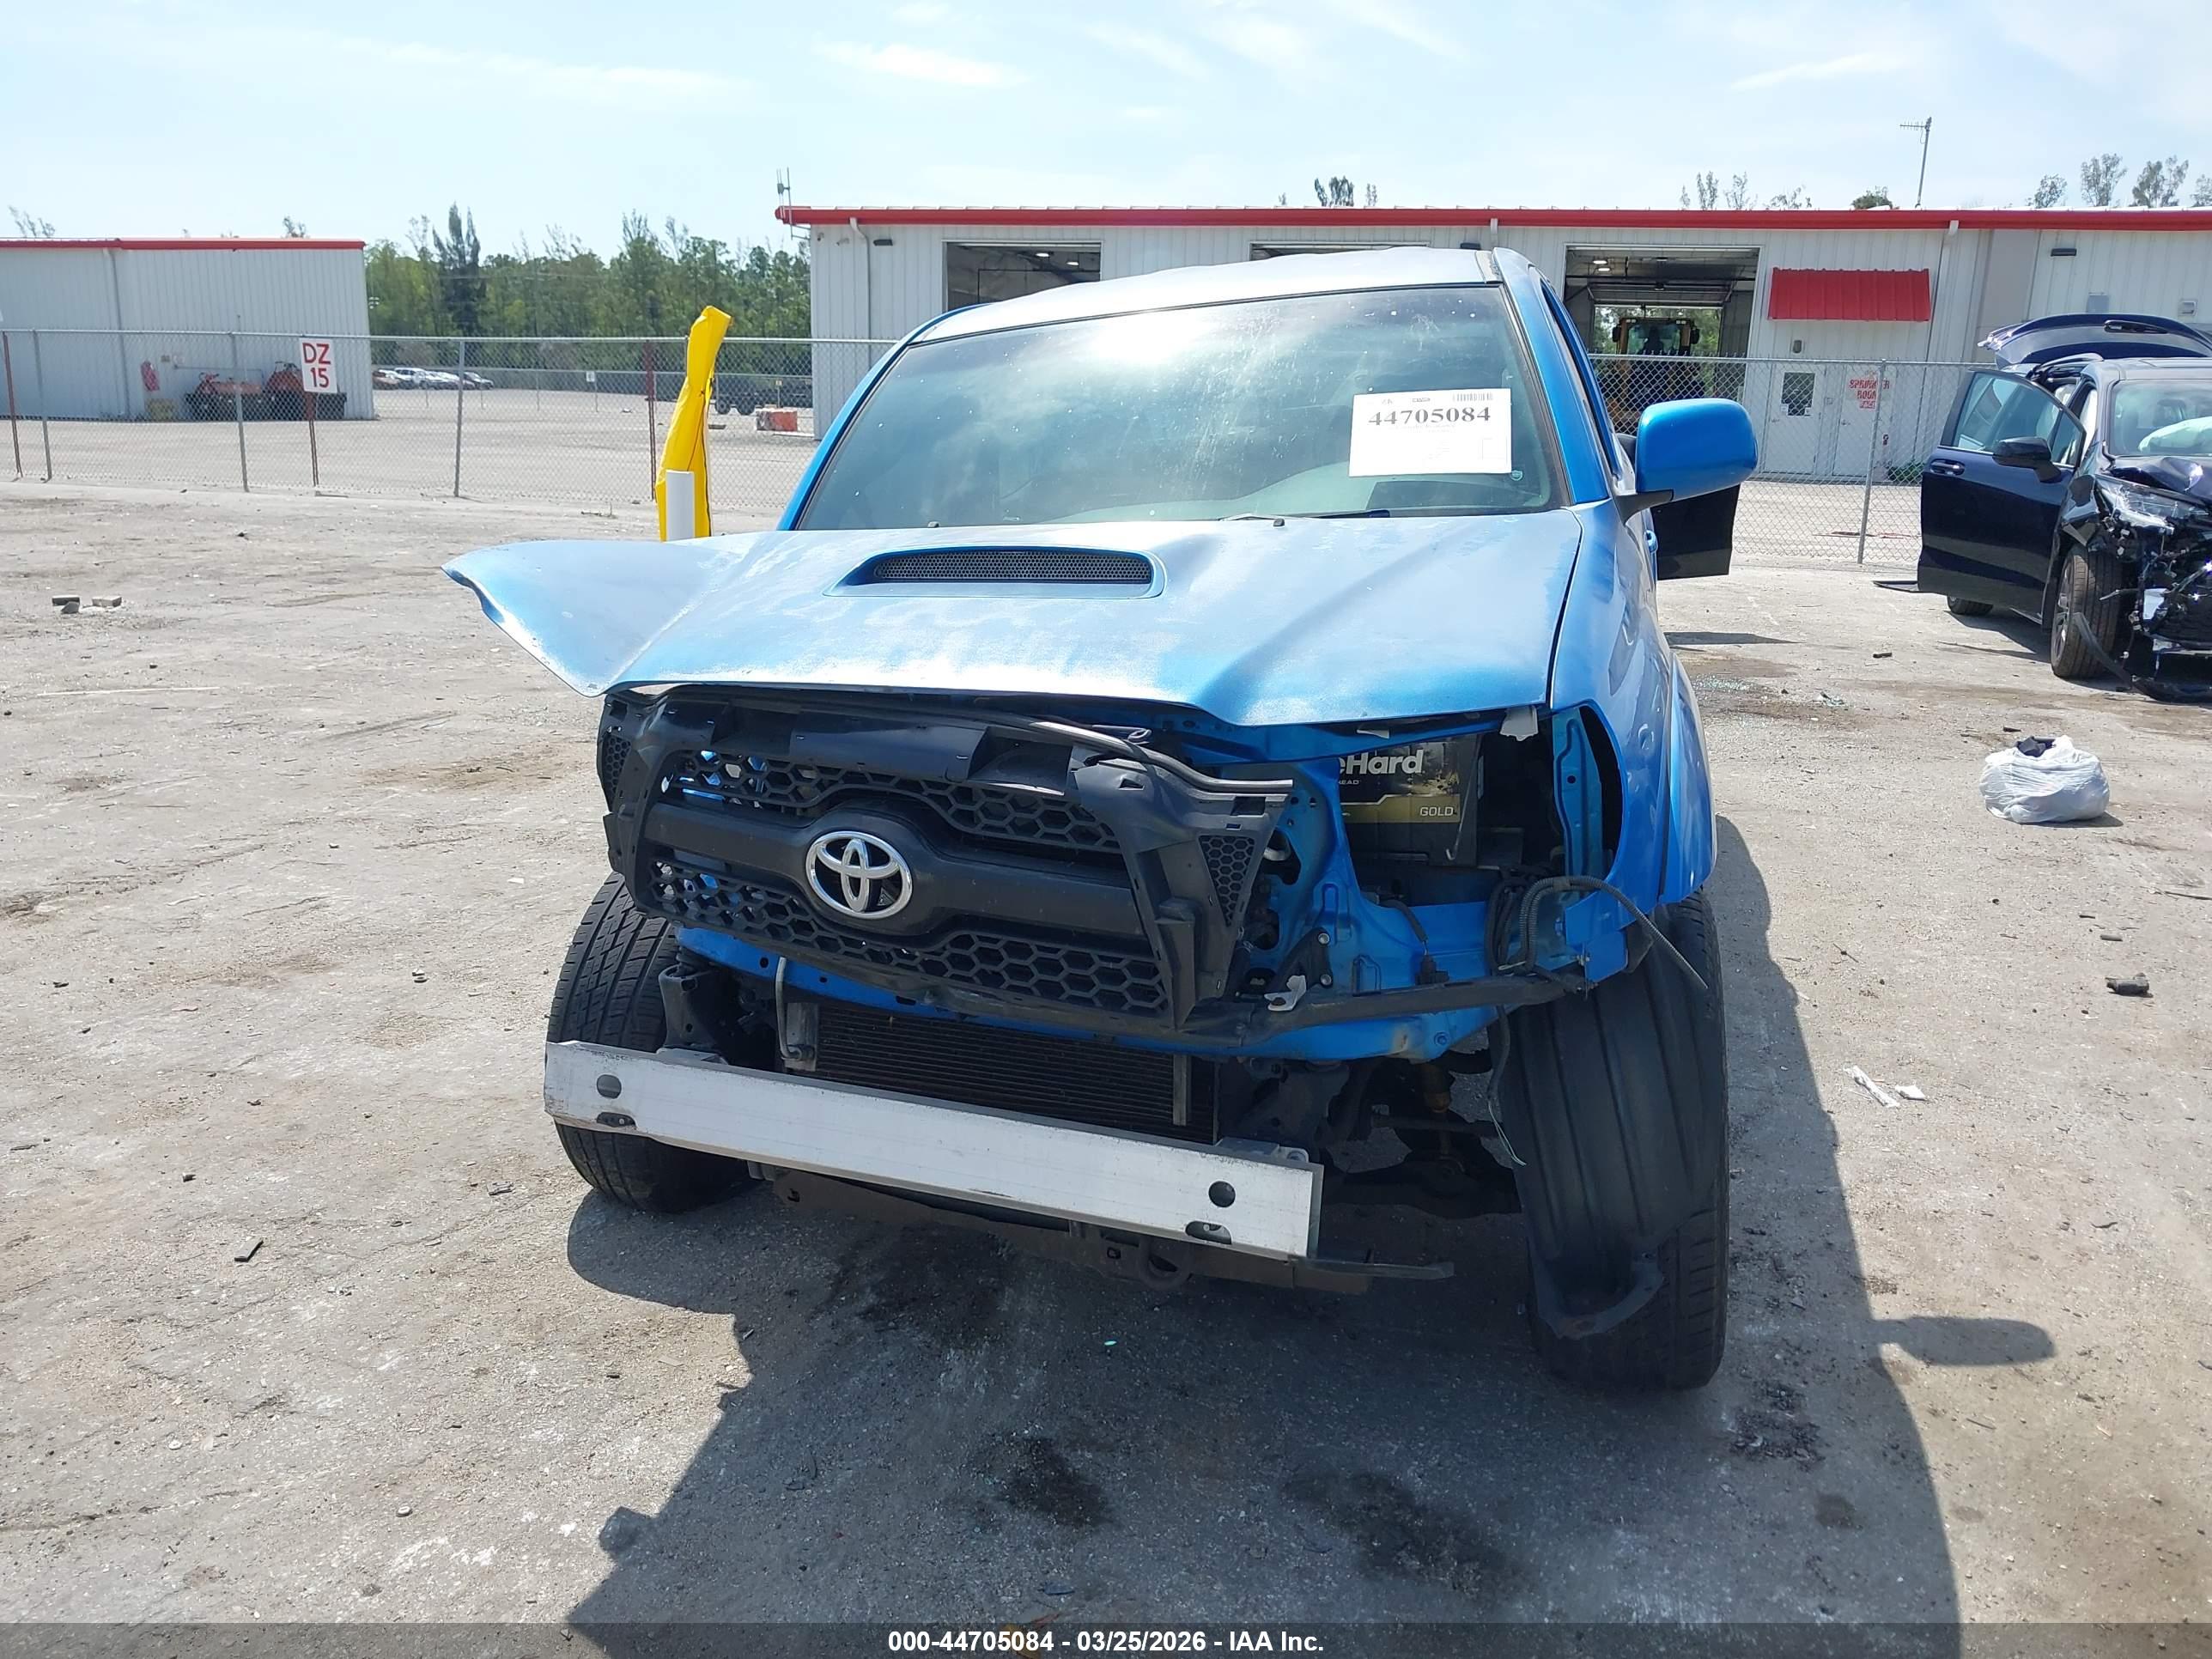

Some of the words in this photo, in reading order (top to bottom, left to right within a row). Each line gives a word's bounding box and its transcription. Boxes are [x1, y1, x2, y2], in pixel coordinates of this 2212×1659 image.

[302, 343, 331, 365] DZ
[310, 368, 330, 388] 15
[1369, 407, 1491, 426] 44705084
[1420, 807, 1454, 817] GOLD
